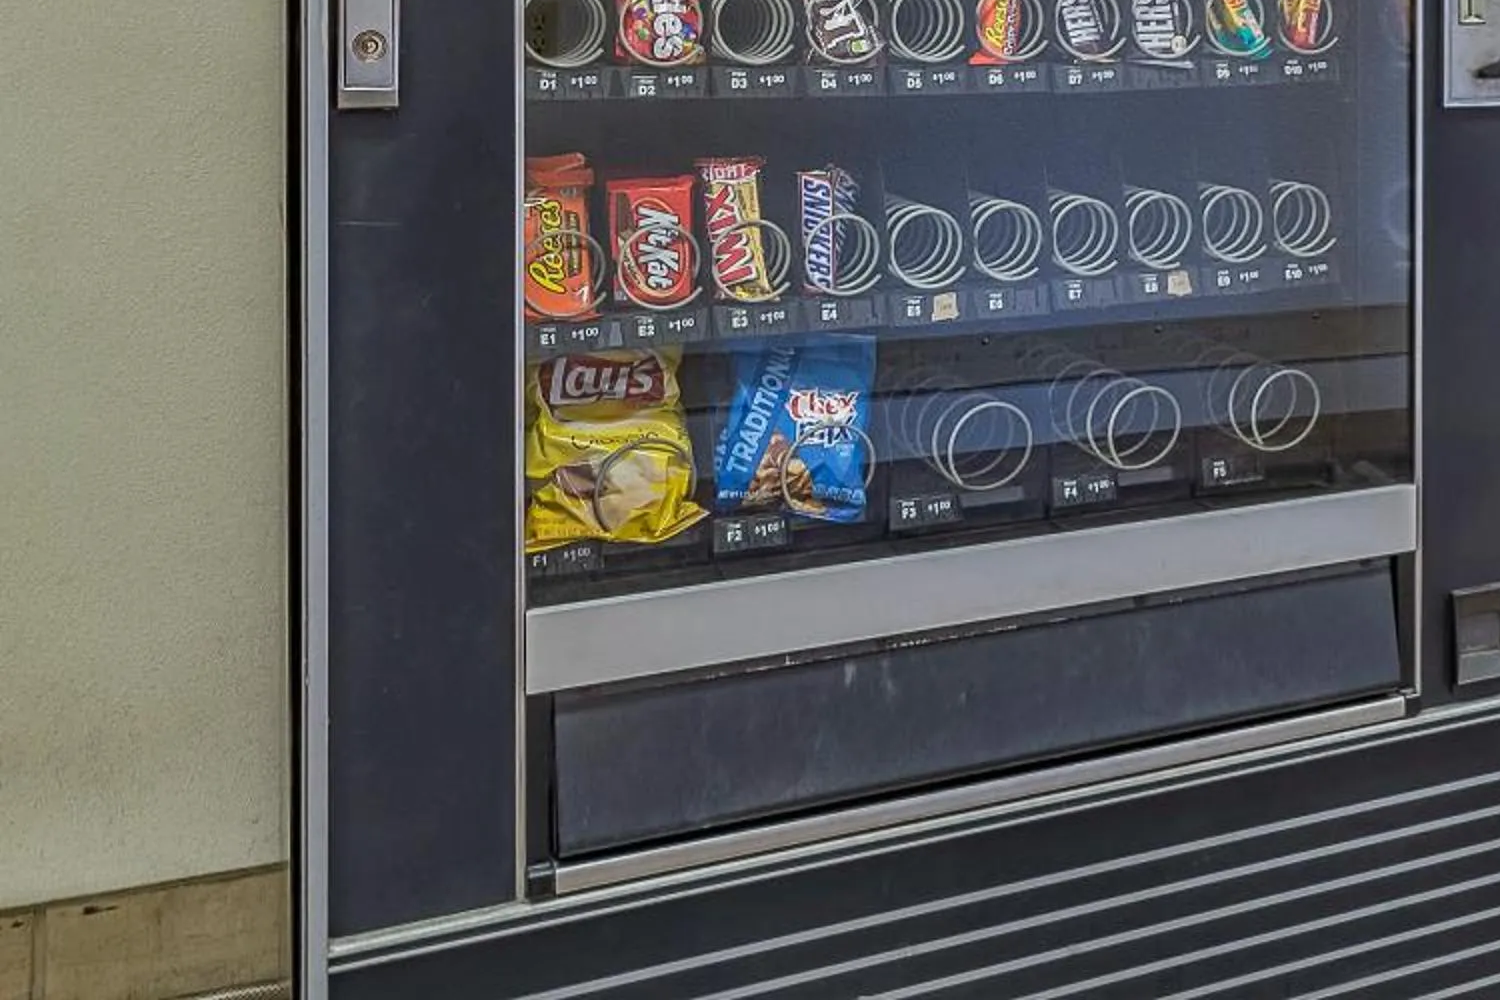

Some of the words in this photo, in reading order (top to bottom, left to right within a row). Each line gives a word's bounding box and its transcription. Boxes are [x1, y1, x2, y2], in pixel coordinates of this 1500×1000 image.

[539, 79, 556, 90] D1
[731, 78, 747, 89] D3
[821, 78, 837, 89] D4
[907, 78, 922, 89] D5
[639, 85, 656, 96] D2
[804, 177, 831, 289] SNICKERS
[528, 199, 567, 294] Reese's
[638, 243, 679, 289] Kat
[821, 310, 837, 321] E4
[732, 318, 748, 329] E3
[638, 326, 654, 337] E2
[540, 333, 556, 345] E1
[549, 356, 653, 405] Lay's
[726, 346, 796, 473] TRADITIONAL
[789, 389, 858, 420] Chex
[727, 531, 742, 543] F2
[533, 554, 547, 567] F1
